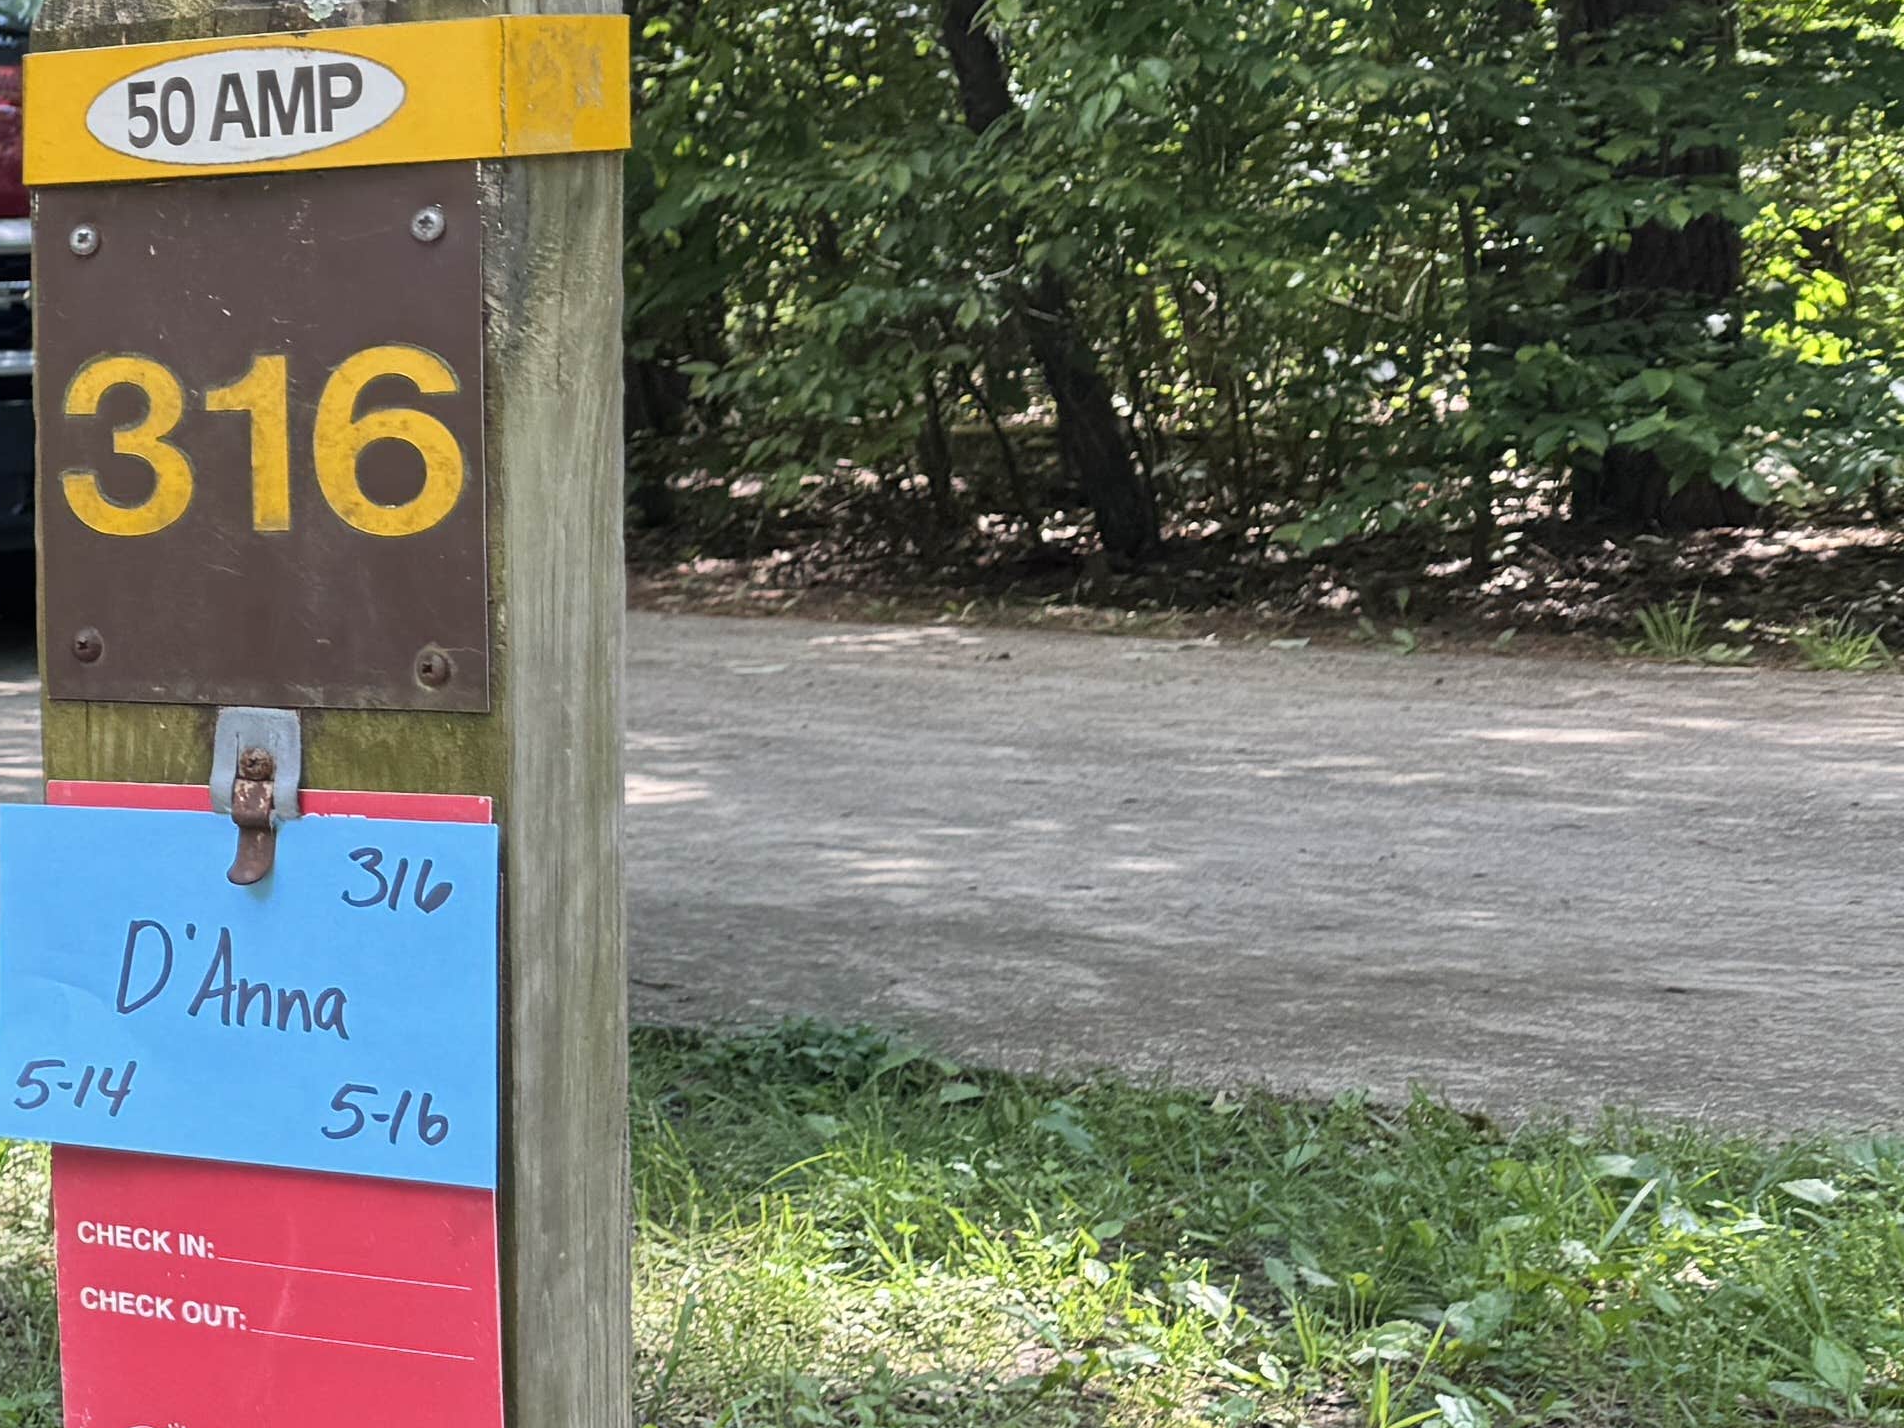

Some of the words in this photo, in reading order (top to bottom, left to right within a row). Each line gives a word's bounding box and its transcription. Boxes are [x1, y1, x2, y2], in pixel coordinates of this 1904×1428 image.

[127, 76, 195, 149] 50
[209, 61, 363, 142] AMP
[62, 345, 465, 537] 316
[341, 847, 453, 914] 316
[116, 920, 350, 1040] D'Anna
[13, 1059, 137, 1117] 5-14
[321, 1083, 449, 1146] 5-16
[77, 1221, 172, 1254] CHECK
[179, 1233, 215, 1259] IN:
[80, 1287, 175, 1320] CHECK
[182, 1300, 247, 1330] OUT:
